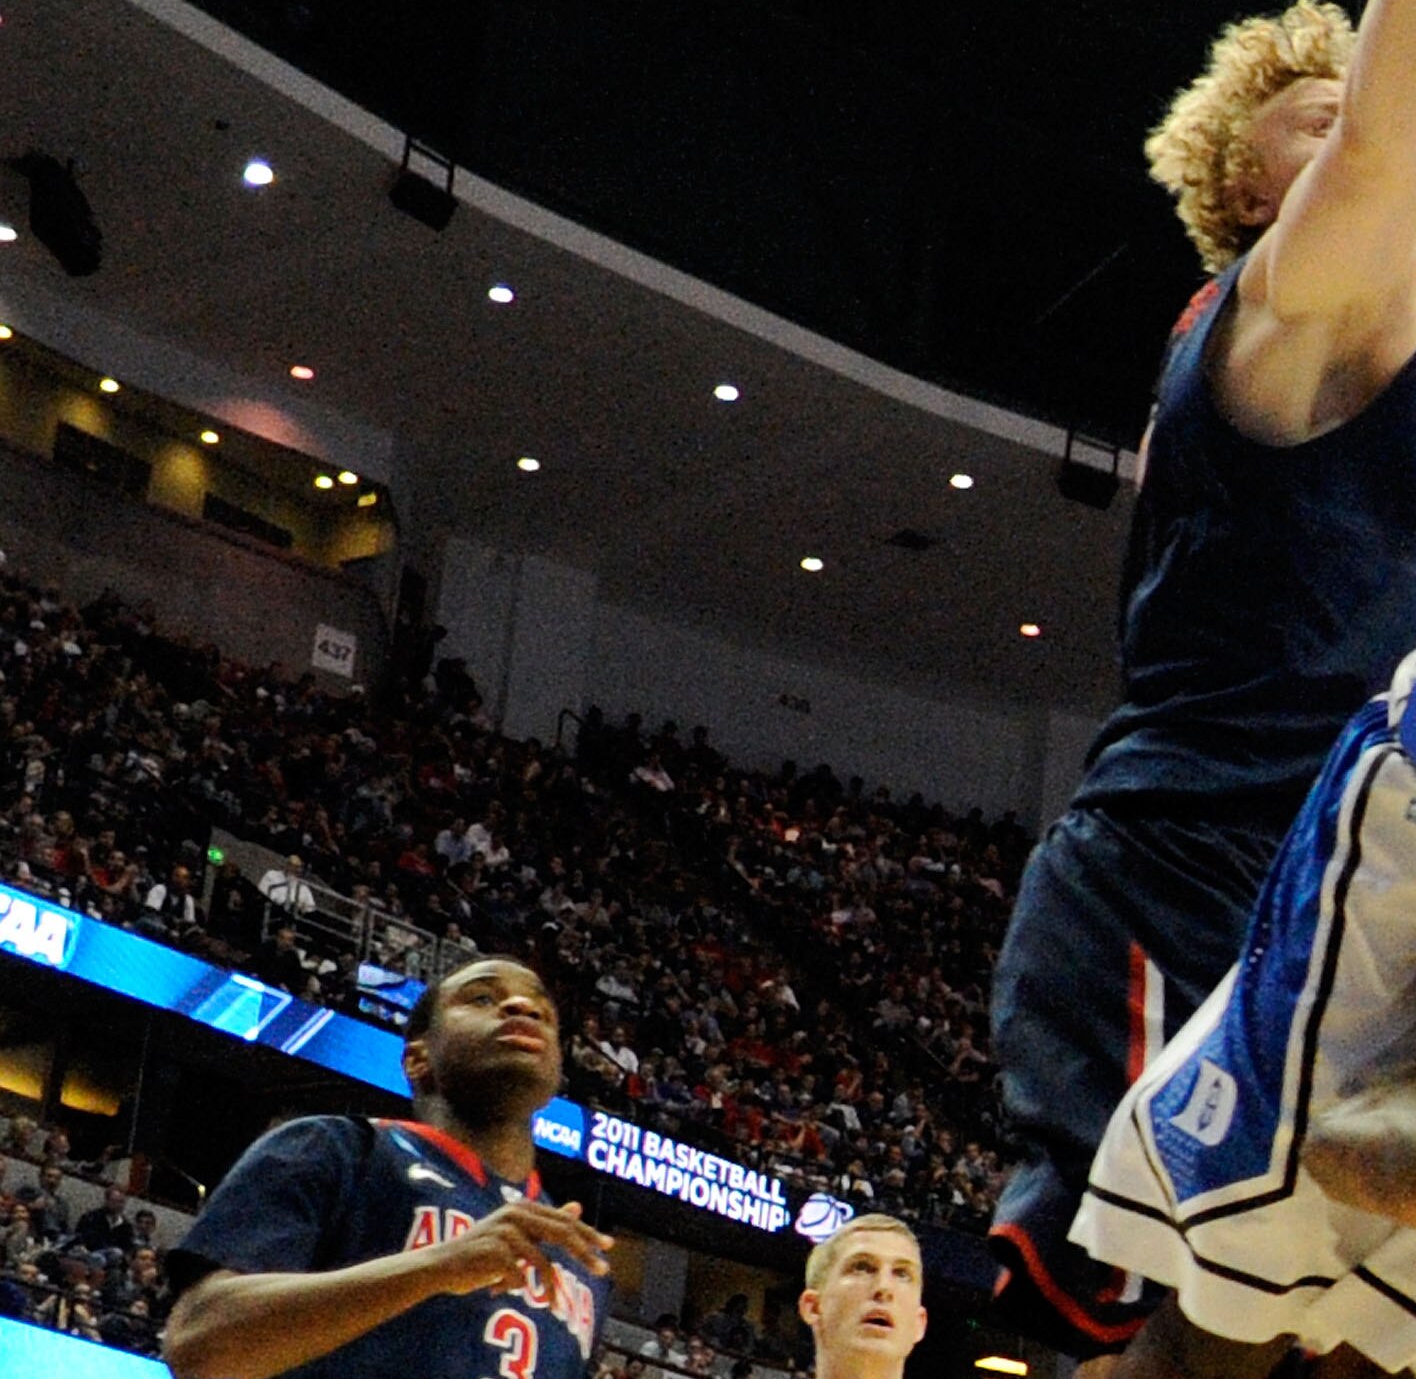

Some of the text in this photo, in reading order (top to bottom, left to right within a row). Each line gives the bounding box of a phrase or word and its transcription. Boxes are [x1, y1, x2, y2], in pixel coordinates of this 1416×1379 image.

[534, 1117, 582, 1150] NCAA
[592, 1112, 787, 1204] 2011 BASKETBALL
[587, 1139, 787, 1232] CHAMPIONSHIP
